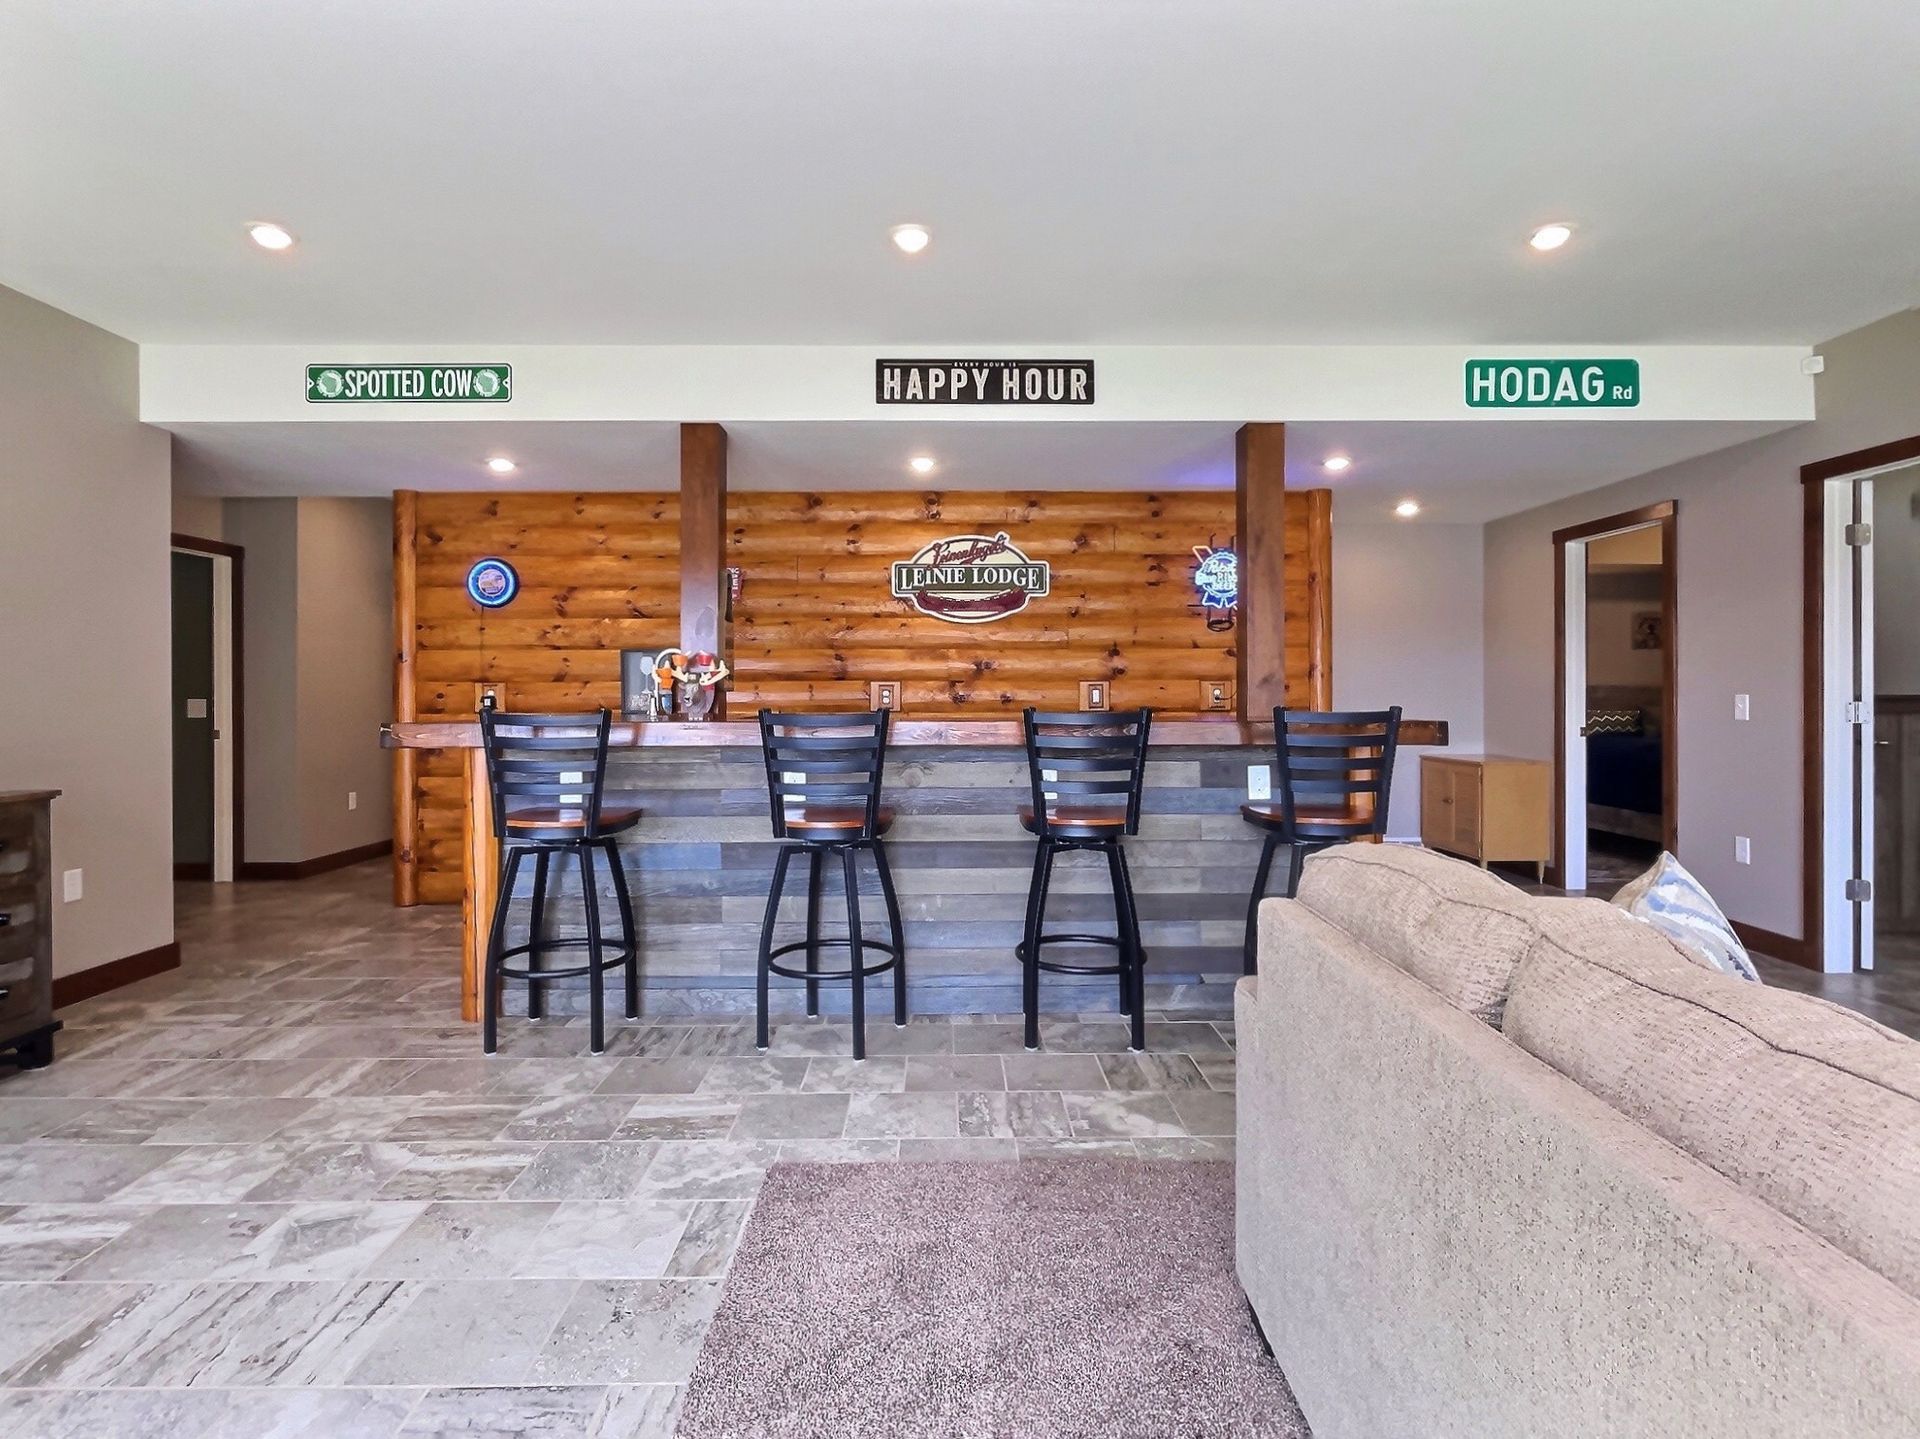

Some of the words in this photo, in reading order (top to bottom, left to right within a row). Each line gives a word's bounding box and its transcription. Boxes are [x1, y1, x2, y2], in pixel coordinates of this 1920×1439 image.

[344, 369, 425, 397] SPOTTED
[431, 369, 473, 397] COW
[883, 368, 989, 400] HAPPY
[1002, 368, 1087, 400] HOUR
[1473, 366, 1605, 402] HODAG
[1612, 386, 1633, 400] Rd
[900, 567, 966, 590] LEINIE
[972, 567, 1040, 590] LODGE
